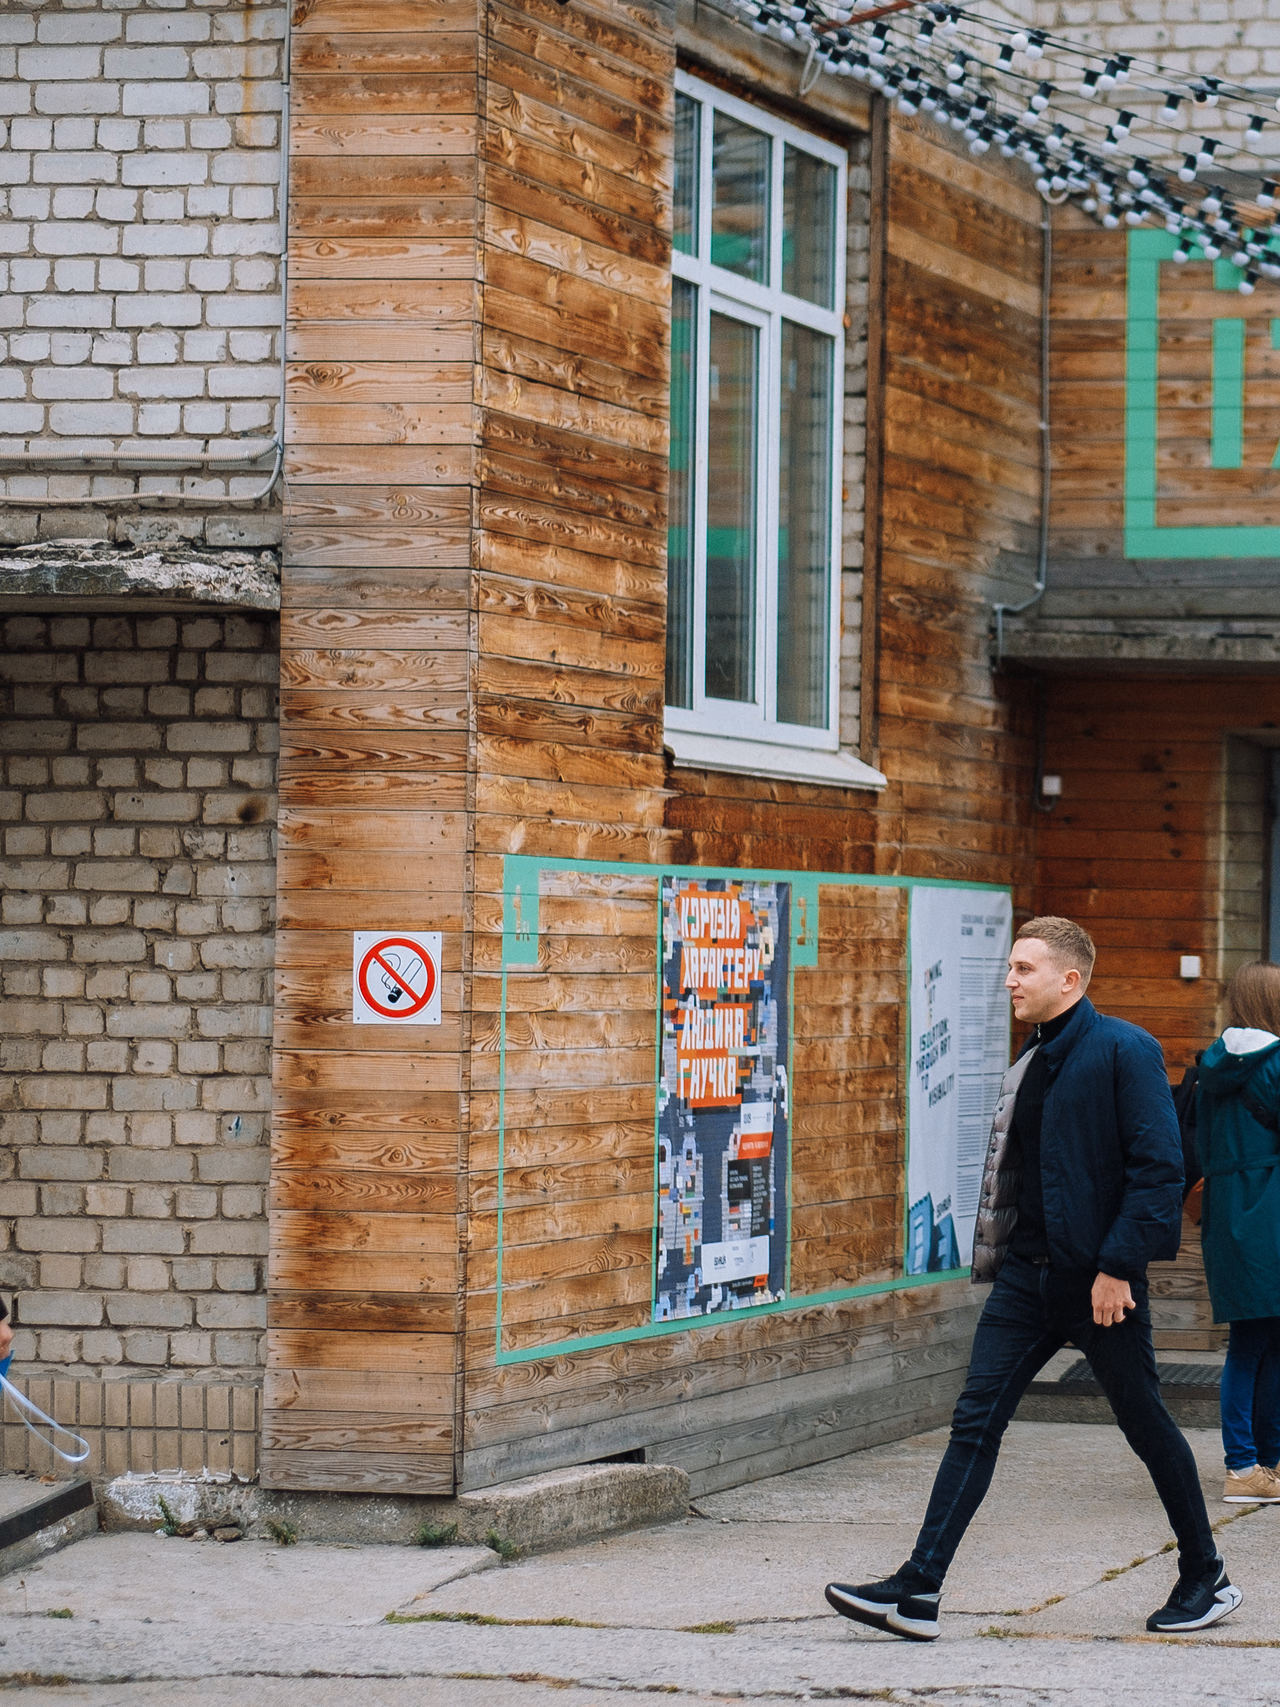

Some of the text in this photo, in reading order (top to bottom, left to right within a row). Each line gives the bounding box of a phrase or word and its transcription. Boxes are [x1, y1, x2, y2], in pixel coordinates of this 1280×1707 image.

[683, 947, 761, 989] ХАРАКТЕРУ
[680, 1008, 745, 1050] ЛЮДИНА
[680, 1057, 737, 1100] ГНУЧКА
